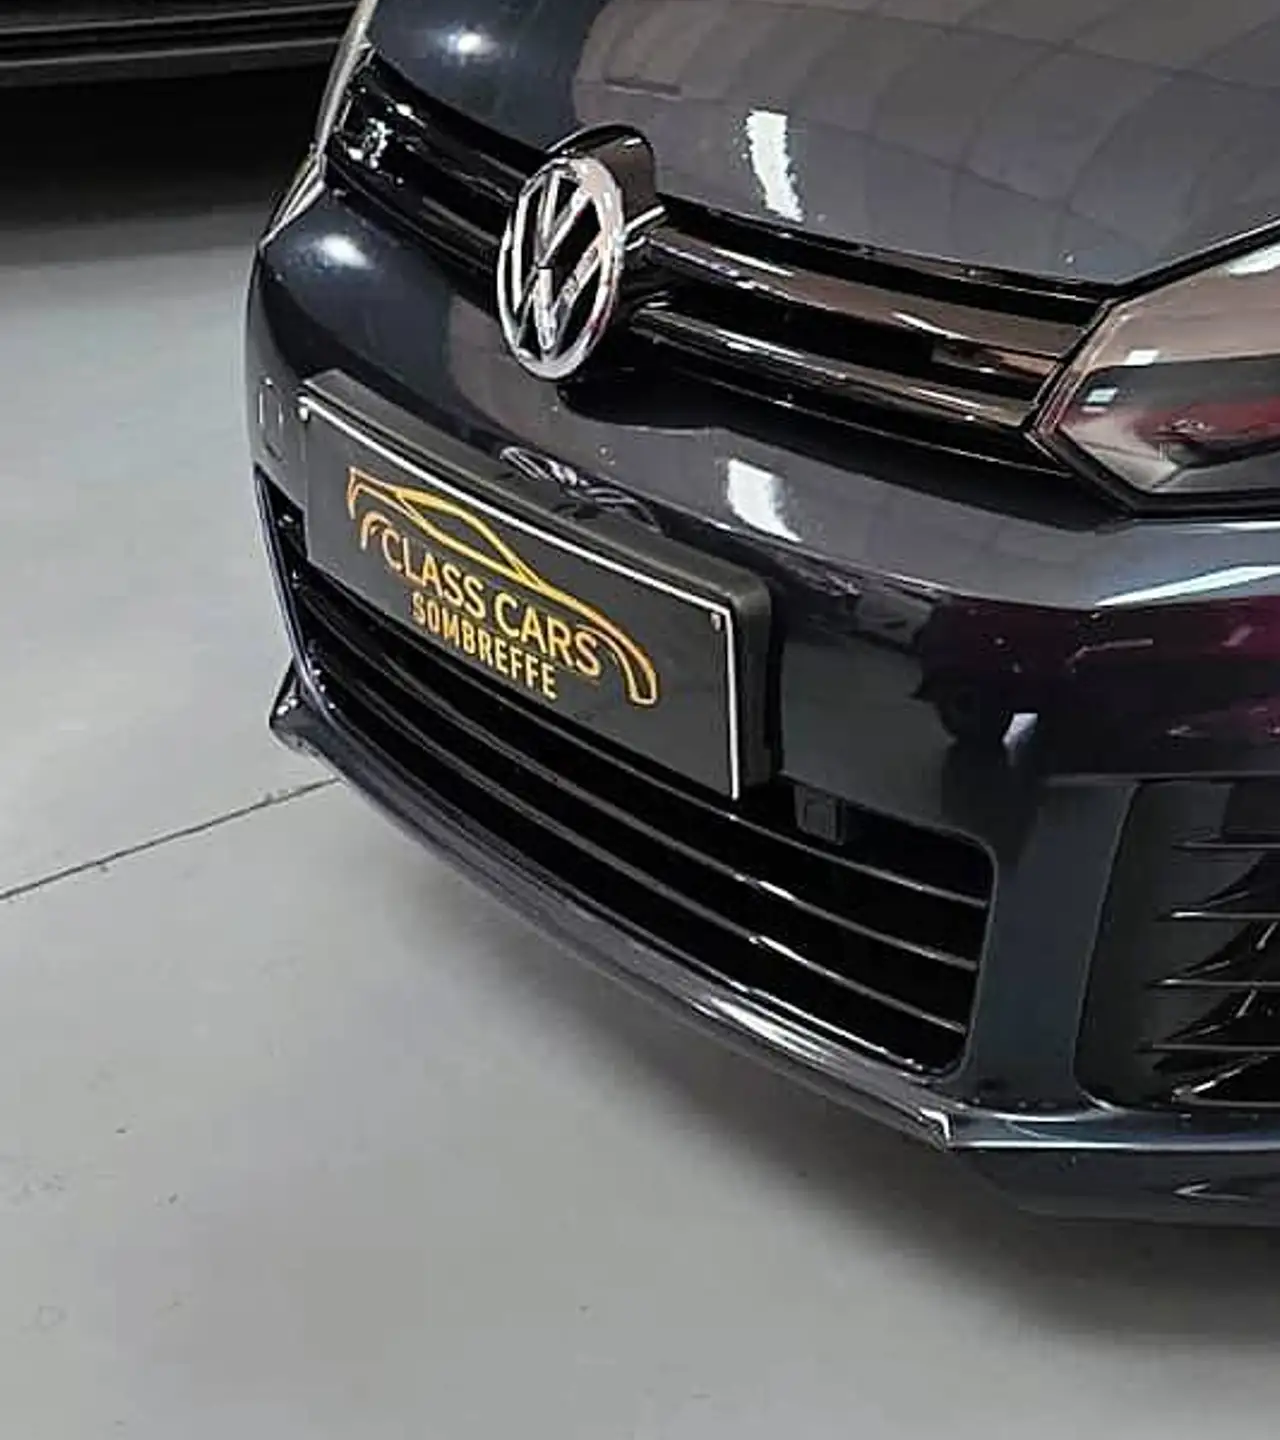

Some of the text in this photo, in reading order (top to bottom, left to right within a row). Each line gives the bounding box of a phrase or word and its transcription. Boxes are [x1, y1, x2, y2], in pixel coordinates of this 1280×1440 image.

[380, 527, 603, 681] CLASS CARS
[411, 590, 559, 701] SOMBREFFE
